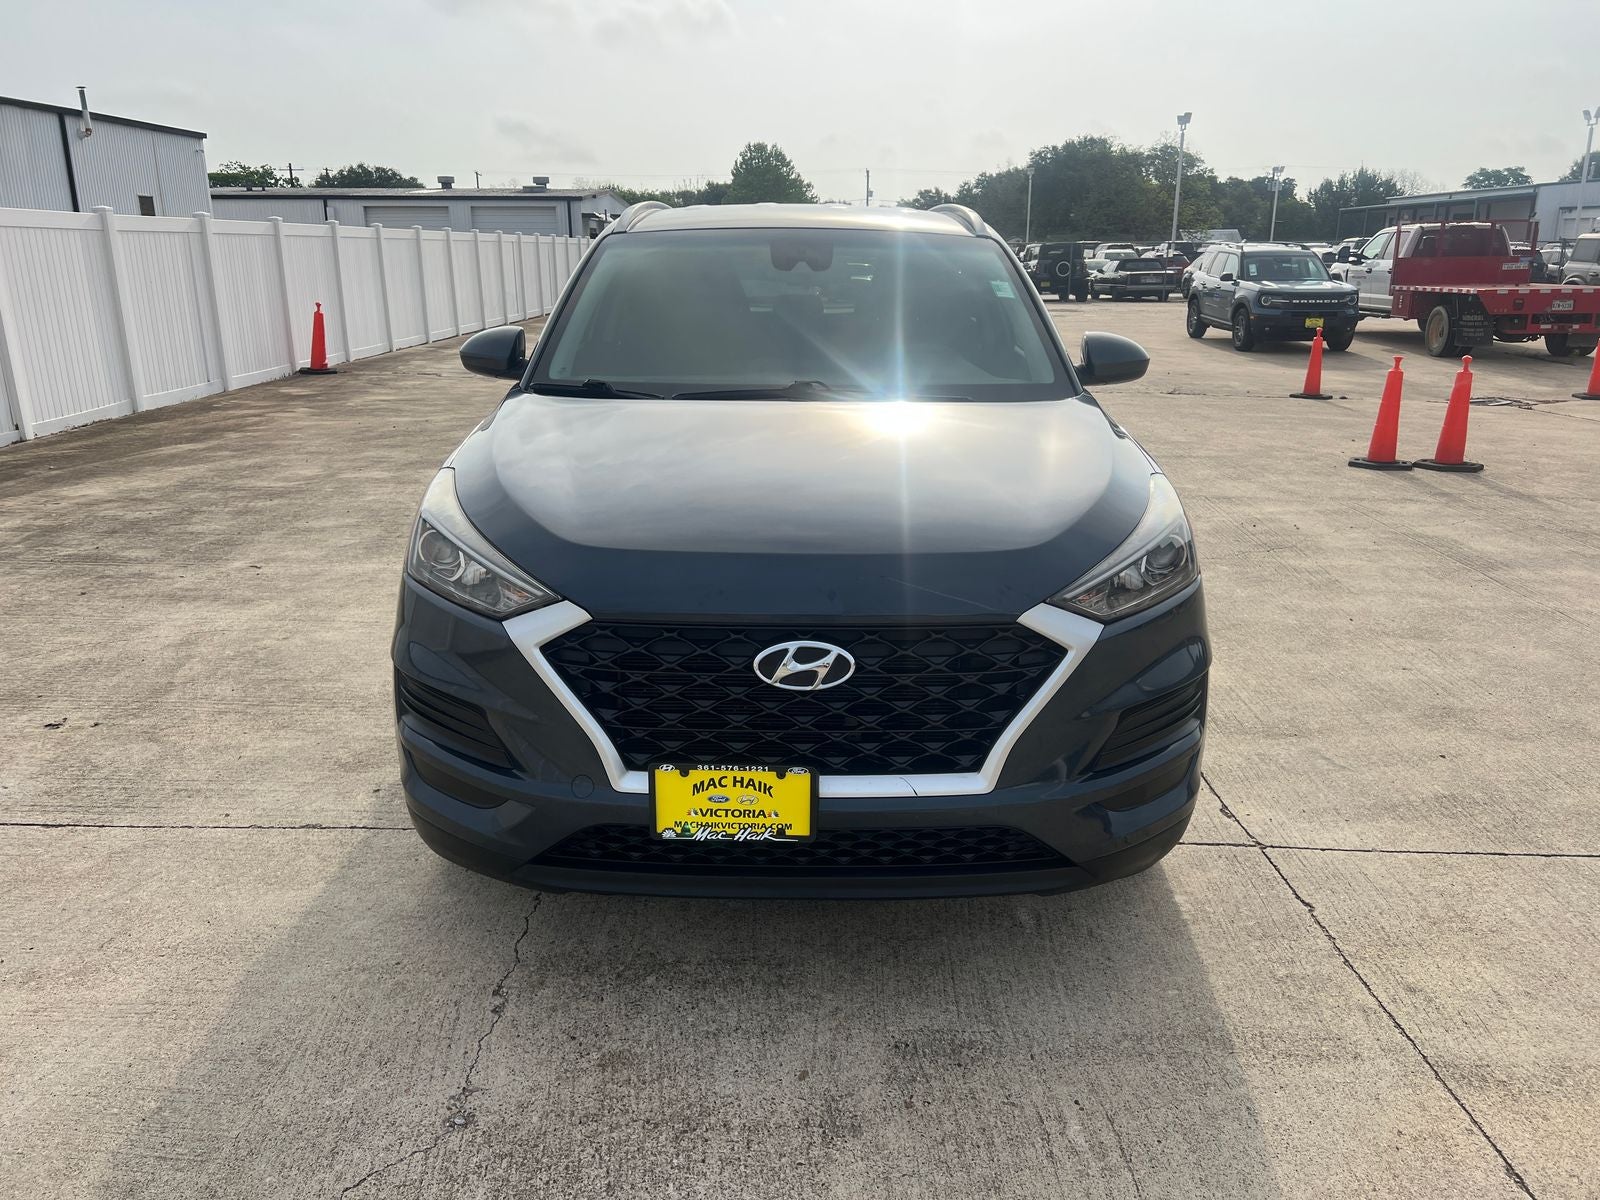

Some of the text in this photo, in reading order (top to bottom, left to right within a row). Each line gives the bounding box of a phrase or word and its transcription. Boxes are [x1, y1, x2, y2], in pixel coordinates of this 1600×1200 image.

[696, 764, 769, 772] 361-576-1221
[692, 775, 774, 798] MAC HAIK
[699, 808, 767, 819] VICTORIA
[673, 820, 793, 831] MACHAIKVICTORIACOM
[693, 826, 777, 842] Mac Haik
